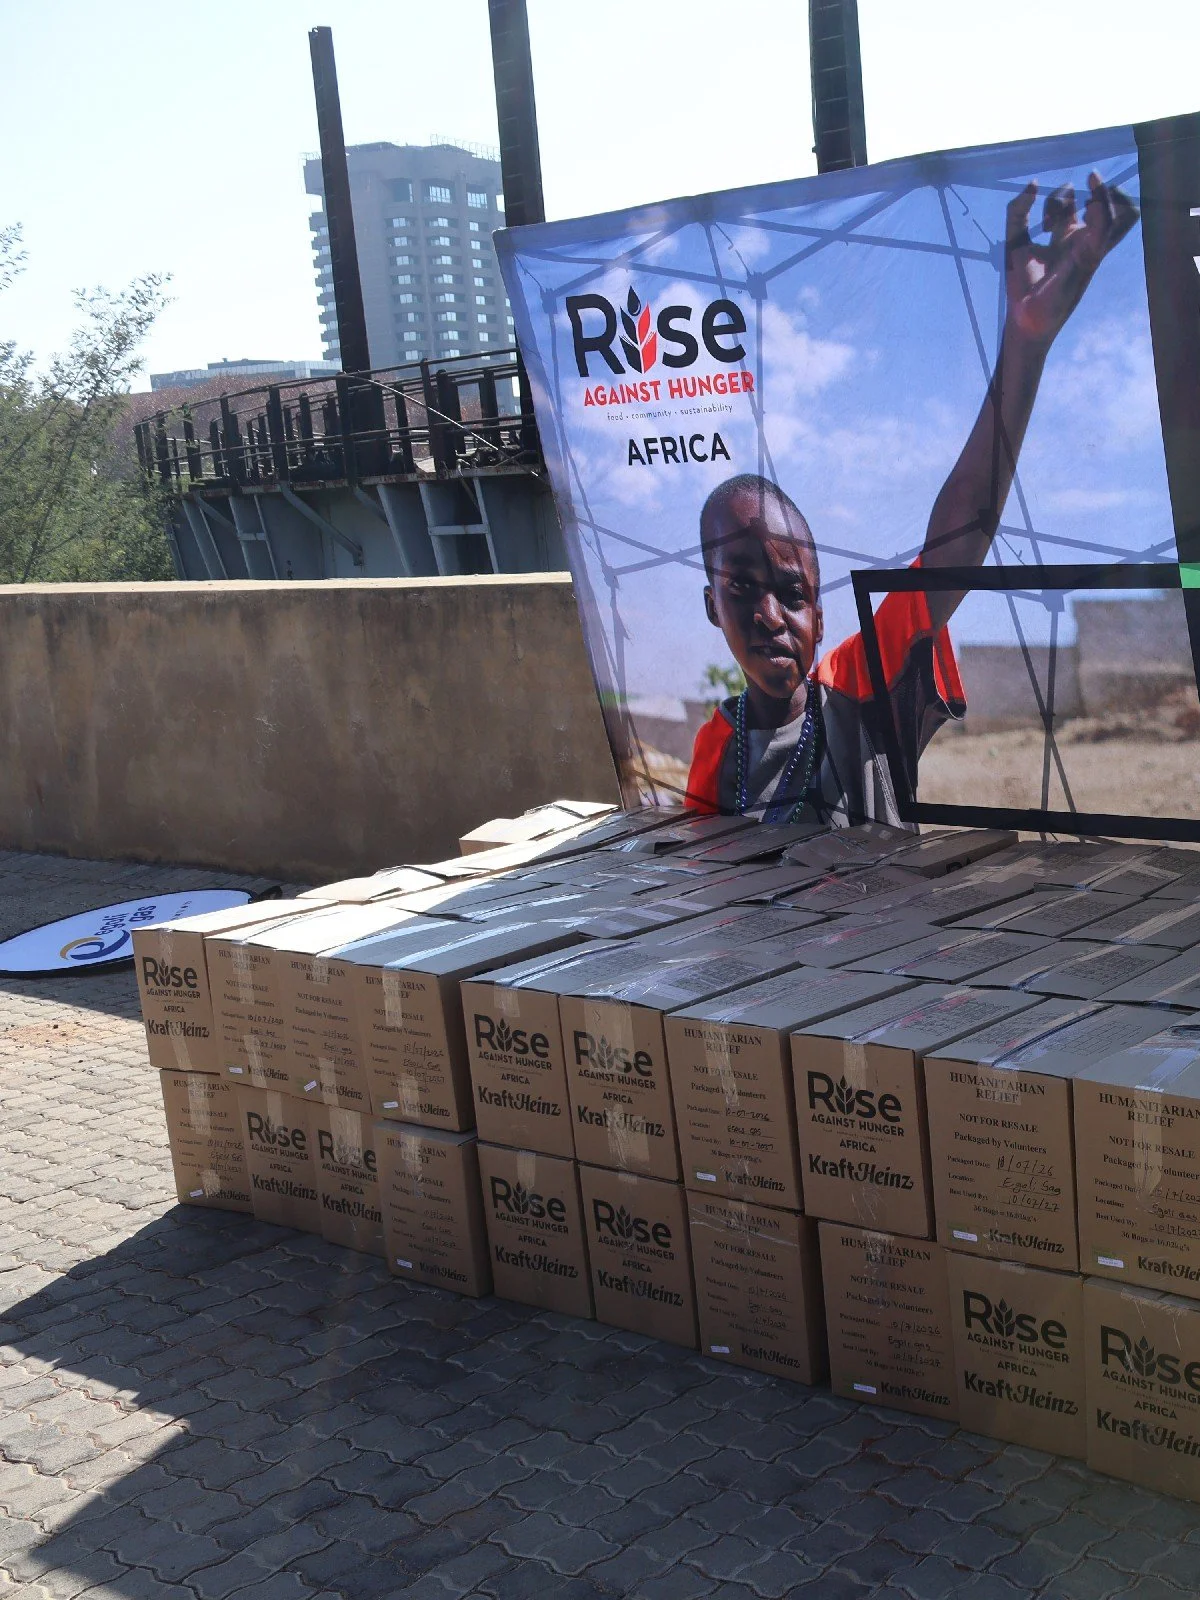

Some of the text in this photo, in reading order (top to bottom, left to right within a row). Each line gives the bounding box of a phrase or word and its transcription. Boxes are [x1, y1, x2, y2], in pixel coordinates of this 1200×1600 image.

[566, 285, 747, 378] Rise
[584, 371, 755, 407] AGAINST HUNGER
[632, 409, 671, 421] community
[680, 403, 733, 417] sustainability
[628, 432, 731, 467] AFRICA
[128, 905, 157, 923] gas
[173, 989, 200, 999] HUNGER
[163, 1005, 186, 1013] AFRICA
[684, 1027, 762, 1047] HUMANITARIAN
[478, 1052, 513, 1065] AGAINST
[515, 1057, 553, 1071] HUNGER
[500, 1072, 531, 1086] AFRICA
[578, 1068, 617, 1083] AGAINST
[618, 1076, 657, 1091] HUNGER
[950, 1071, 1045, 1096] HUMANITARIAN
[477, 1085, 561, 1118] KraftHeinz
[602, 1091, 635, 1105] AFRICA
[975, 1087, 1019, 1104] RELIEF
[811, 1113, 855, 1129] AGAINST
[858, 1120, 905, 1137] HUNGER
[959, 1112, 1038, 1133] NOT FOR RESALE
[1127, 1110, 1175, 1129] RELIEF
[252, 1144, 309, 1161] AGAINST HUNGER
[839, 1138, 876, 1153] AFRICA
[954, 1131, 1047, 1155] Packaged by Volunteers
[1109, 1135, 1196, 1159] NOT FOR RESALE
[269, 1163, 292, 1172] AFRICA
[808, 1153, 914, 1190] KraftHeinz
[1103, 1154, 1140, 1171] Packaged
[1143, 1161, 1154, 1174] by
[252, 1173, 318, 1201] KraftHeinz
[341, 1183, 364, 1195] AFRICA
[495, 1211, 569, 1235] AGAINST HUNGER
[517, 1234, 547, 1248] AFRICA
[598, 1235, 675, 1262] AGAINST HUNGER
[494, 1245, 579, 1280] KraftHeinz
[621, 1259, 653, 1273] AFRICA
[597, 1269, 684, 1308] KraftHeinz
[850, 1274, 869, 1286] NOT
[889, 1282, 925, 1297] RESALE
[893, 1300, 934, 1316] Volunteers
[741, 1343, 801, 1368] KraftHeinz
[967, 1331, 1014, 1351] AGAINST
[1018, 1344, 1070, 1364] HUNGER
[997, 1360, 1037, 1377] AFRICA
[1102, 1368, 1154, 1391] AGAINST
[880, 1380, 951, 1408] KraftHeinz
[964, 1369, 1079, 1416] KraftHeinz
[1134, 1400, 1178, 1420] AFRICA
